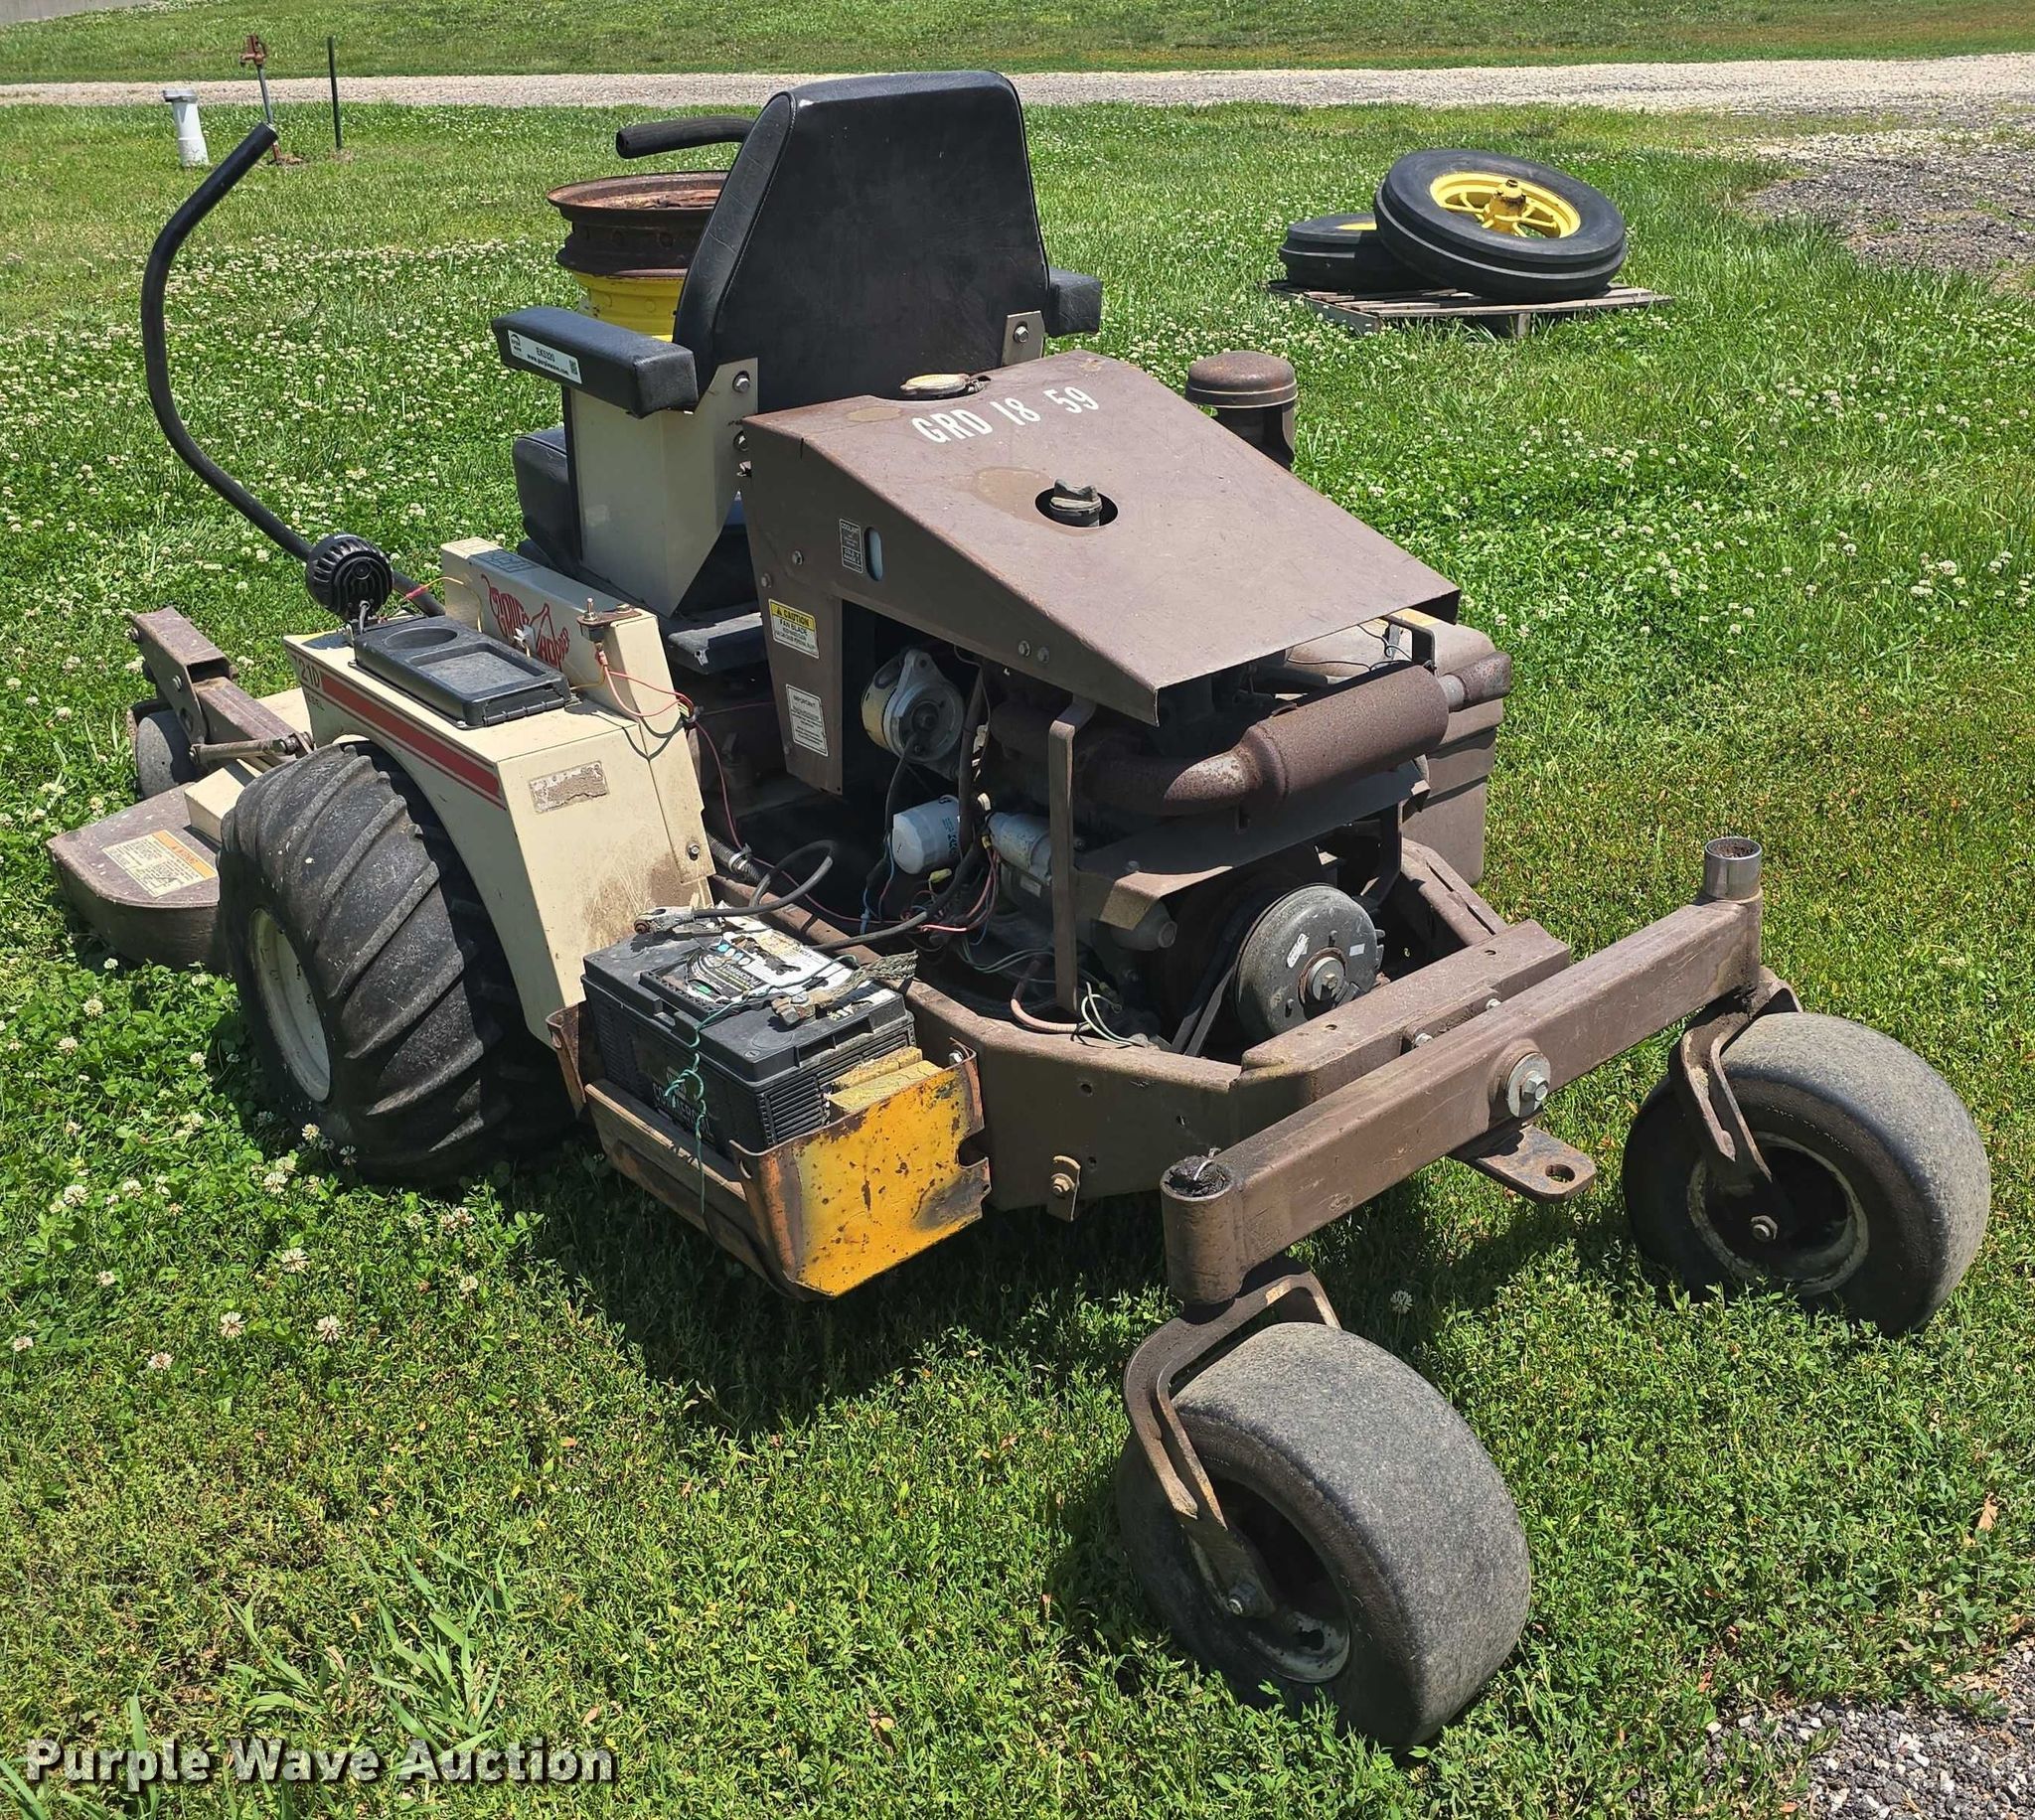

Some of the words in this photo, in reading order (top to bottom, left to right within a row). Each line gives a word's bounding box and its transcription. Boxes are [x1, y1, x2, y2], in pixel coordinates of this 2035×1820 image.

[911, 408, 994, 443] GRD
[990, 397, 1041, 426] 18
[1042, 385, 1100, 414] 59
[779, 618, 792, 629] FAN
[791, 622, 808, 637] BLADE
[783, 609, 811, 627] CAUTION
